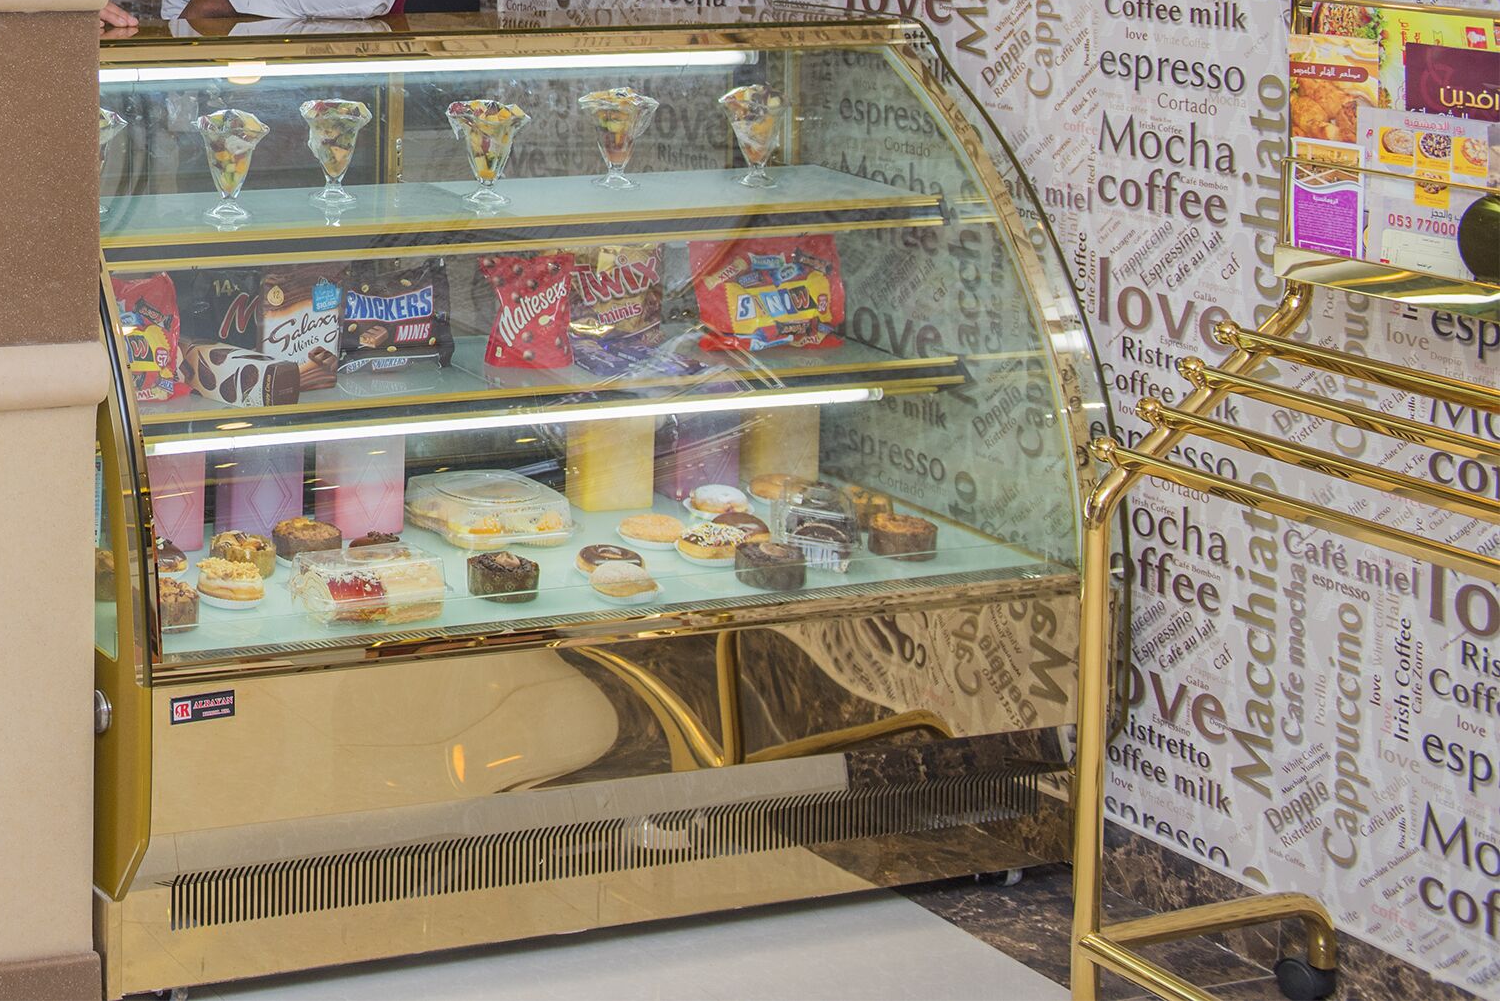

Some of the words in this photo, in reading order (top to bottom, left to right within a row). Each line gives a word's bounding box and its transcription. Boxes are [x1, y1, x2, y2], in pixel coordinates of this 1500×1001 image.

[1101, 46, 1246, 98] espresso
[1157, 92, 1218, 117] Cortado
[1100, 109, 1236, 173] Mocha
[1098, 168, 1228, 225] coffee
[1388, 214, 1412, 229] 053
[345, 286, 434, 322] SNICKERS
[499, 277, 568, 347] Maltesers
[599, 301, 642, 325] minis
[263, 312, 341, 352] Galaxy
[288, 335, 320, 357] Minis
[397, 323, 431, 342] MINIS
[834, 422, 946, 482] espresso
[1283, 528, 1347, 571] Café
[1356, 551, 1420, 596] miel
[1312, 573, 1371, 601] espresso
[1395, 617, 1411, 687] Coffee
[1412, 640, 1424, 679] Zorro
[1394, 693, 1410, 743] Irish
[1411, 682, 1424, 715] Cafe
[1325, 602, 1373, 870] Cappuccino
[1264, 777, 1331, 834] Doppio
[1384, 803, 1405, 825] latte
[1280, 815, 1322, 848] Ristretto
[1381, 881, 1404, 900] Black
[1404, 874, 1417, 887] Tie
